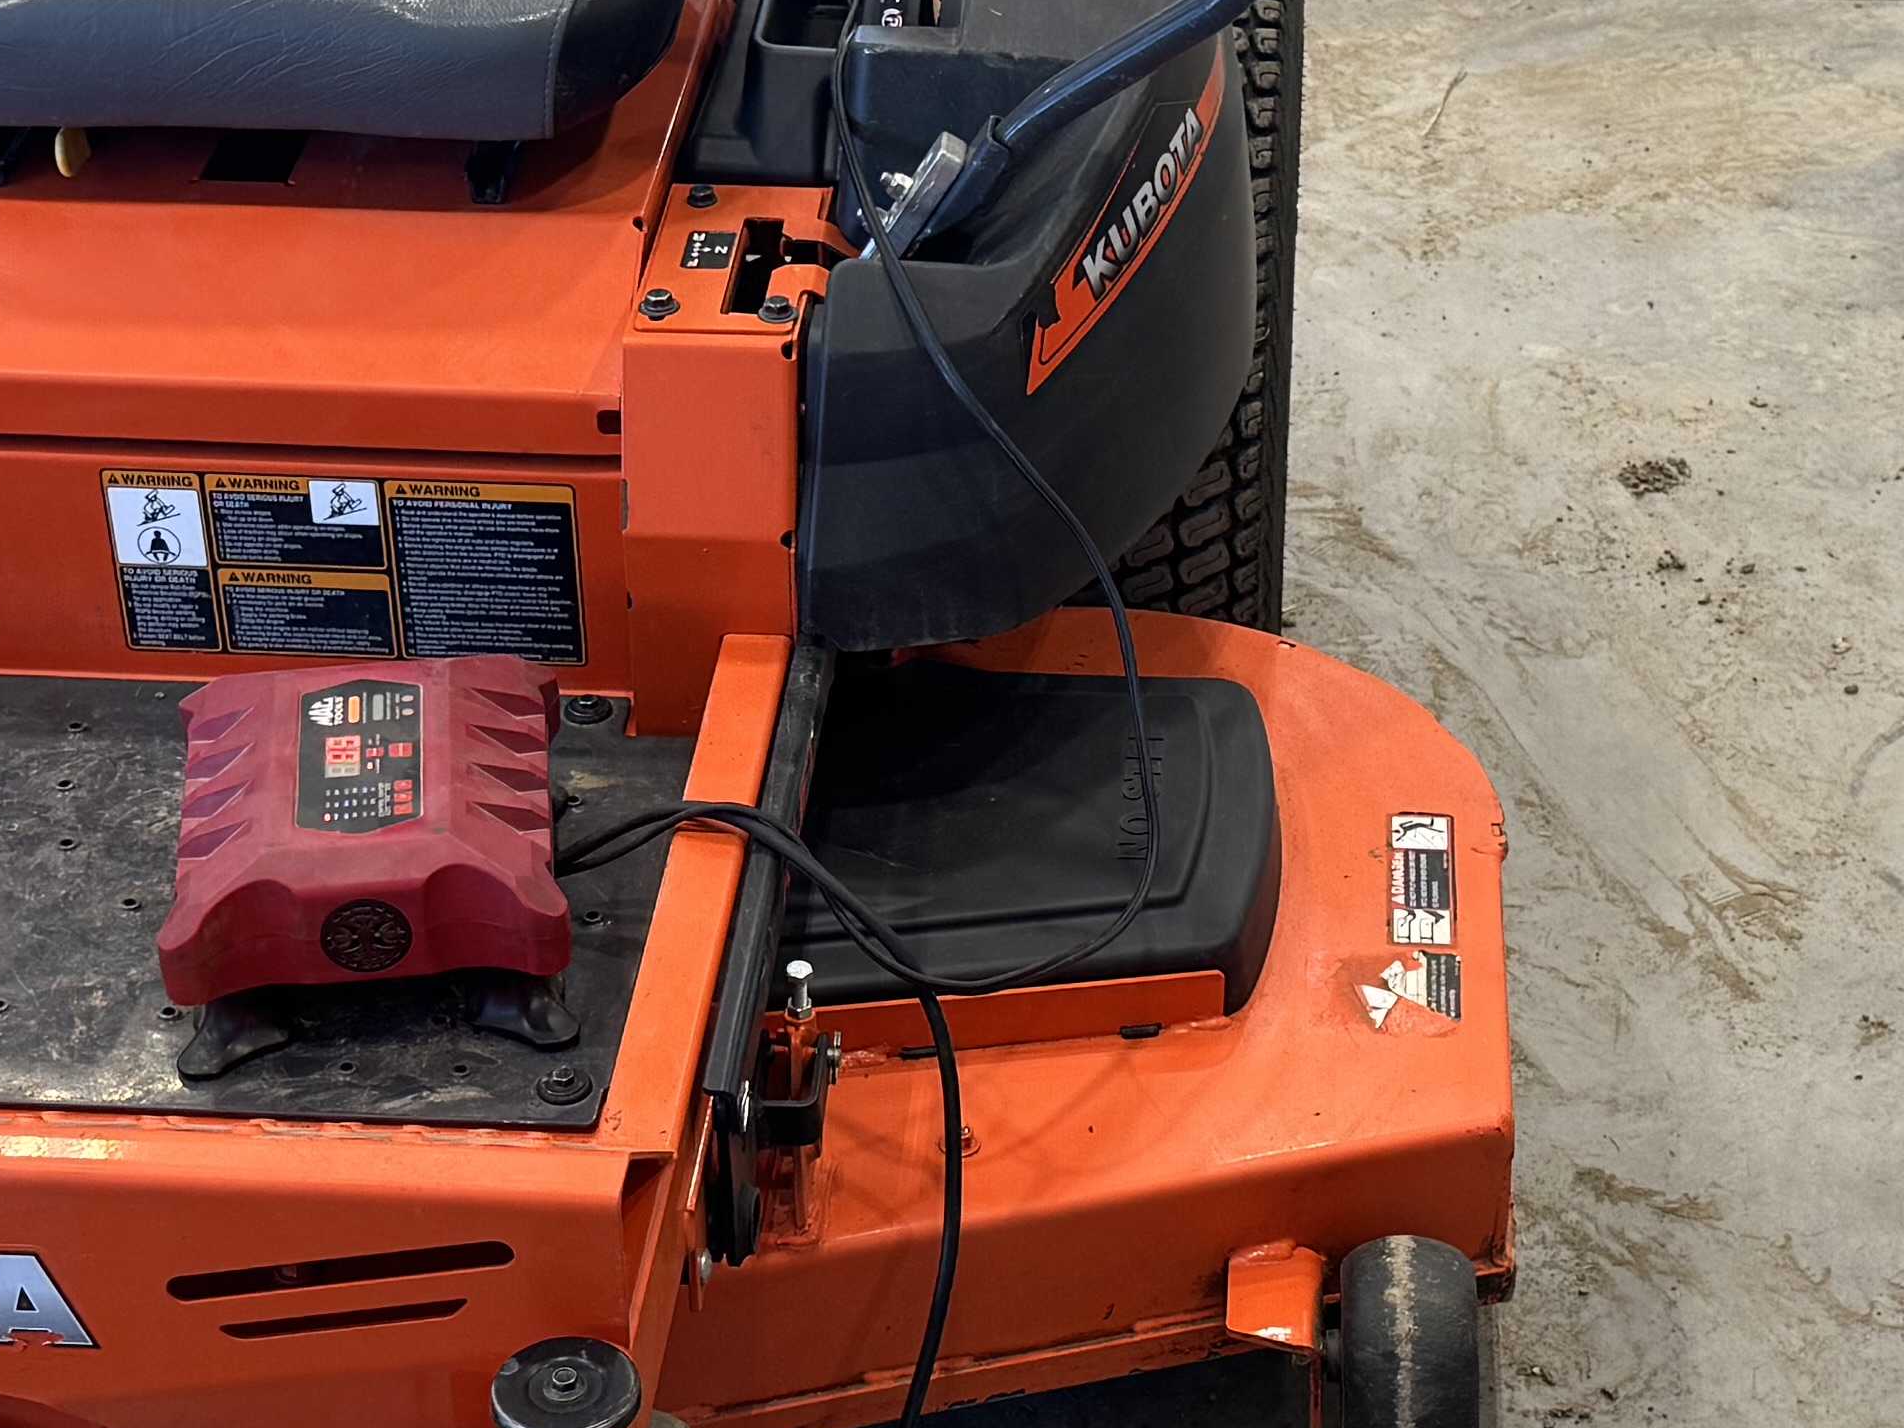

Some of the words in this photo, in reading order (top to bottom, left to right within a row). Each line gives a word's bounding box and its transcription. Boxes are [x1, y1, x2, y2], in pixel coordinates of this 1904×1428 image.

[1082, 107, 1205, 302] KUBOTA
[121, 473, 193, 487] WARNING
[228, 477, 301, 491] WARNING
[409, 483, 481, 498] WARNING
[393, 499, 404, 507] TO
[405, 500, 433, 508] AVOID
[434, 501, 480, 510] PERSONAL
[481, 503, 513, 511] INJURY
[123, 567, 135, 575] TO
[135, 568, 162, 576] AVOID
[162, 568, 199, 577] SERIOUS
[241, 571, 313, 585] WARNING
[307, 695, 334, 727] MAC
[333, 695, 344, 726] TOOLS
[1391, 851, 1405, 898] DANGER
